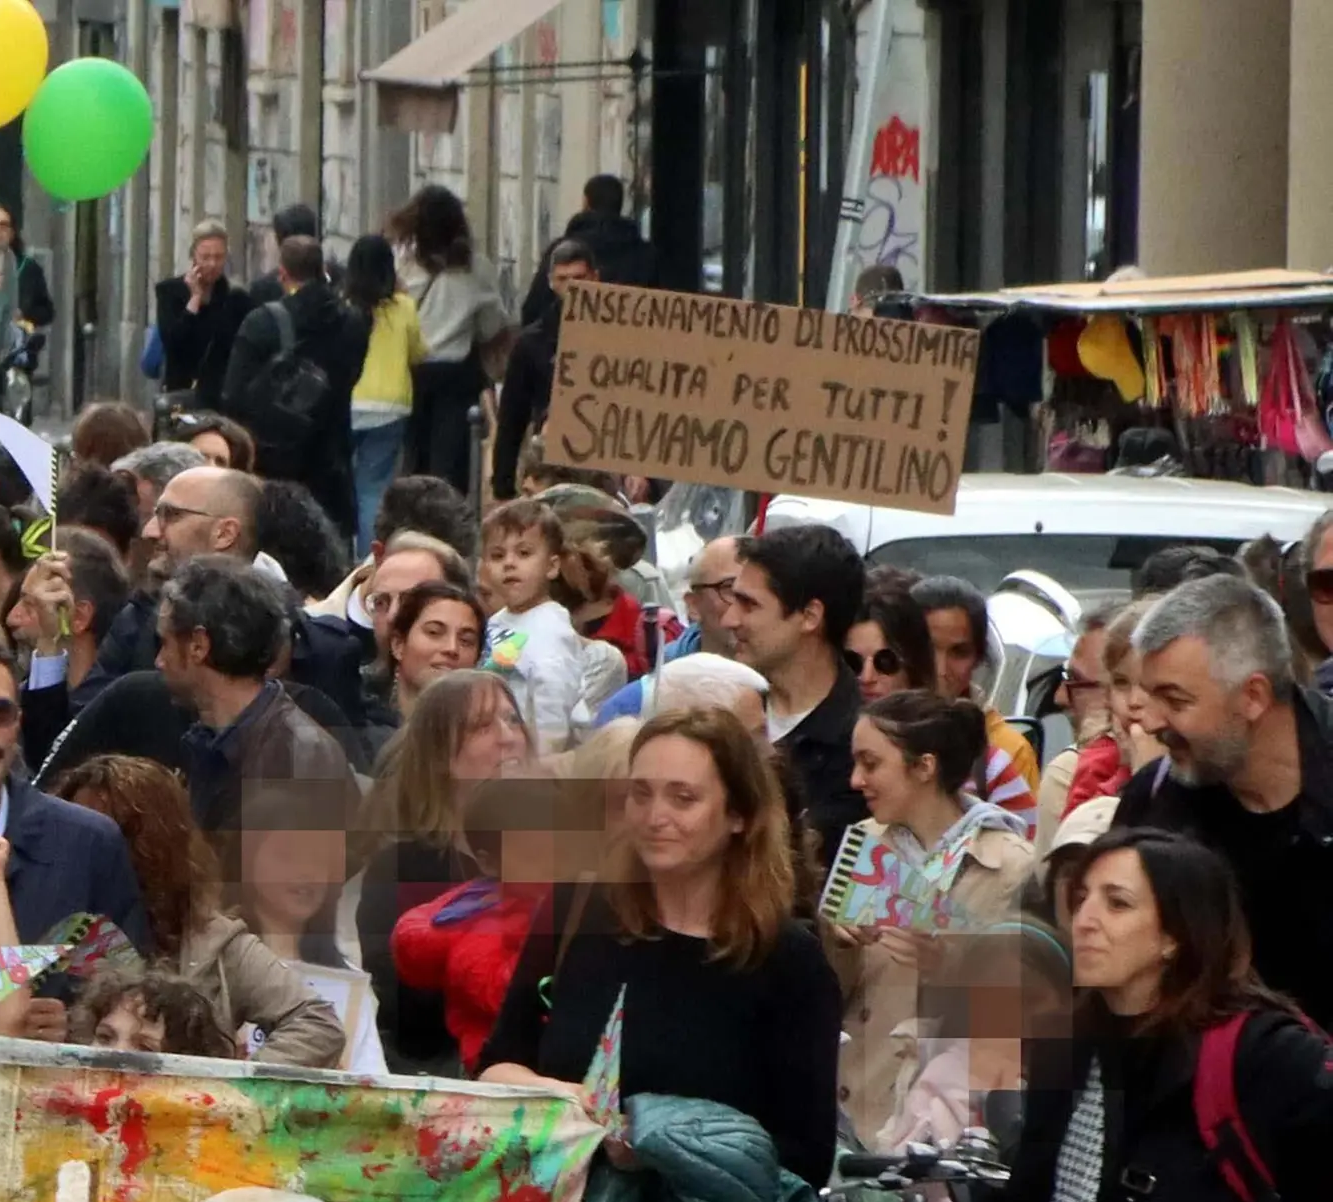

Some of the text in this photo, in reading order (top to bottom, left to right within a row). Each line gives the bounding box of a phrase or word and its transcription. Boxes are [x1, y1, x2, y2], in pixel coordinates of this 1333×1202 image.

[564, 286, 780, 344] INSEGNAMENTO
[794, 309, 825, 349] DI
[558, 352, 577, 388] E
[733, 373, 790, 411] PER
[561, 394, 952, 503] SALVIAMO GENTILINO
